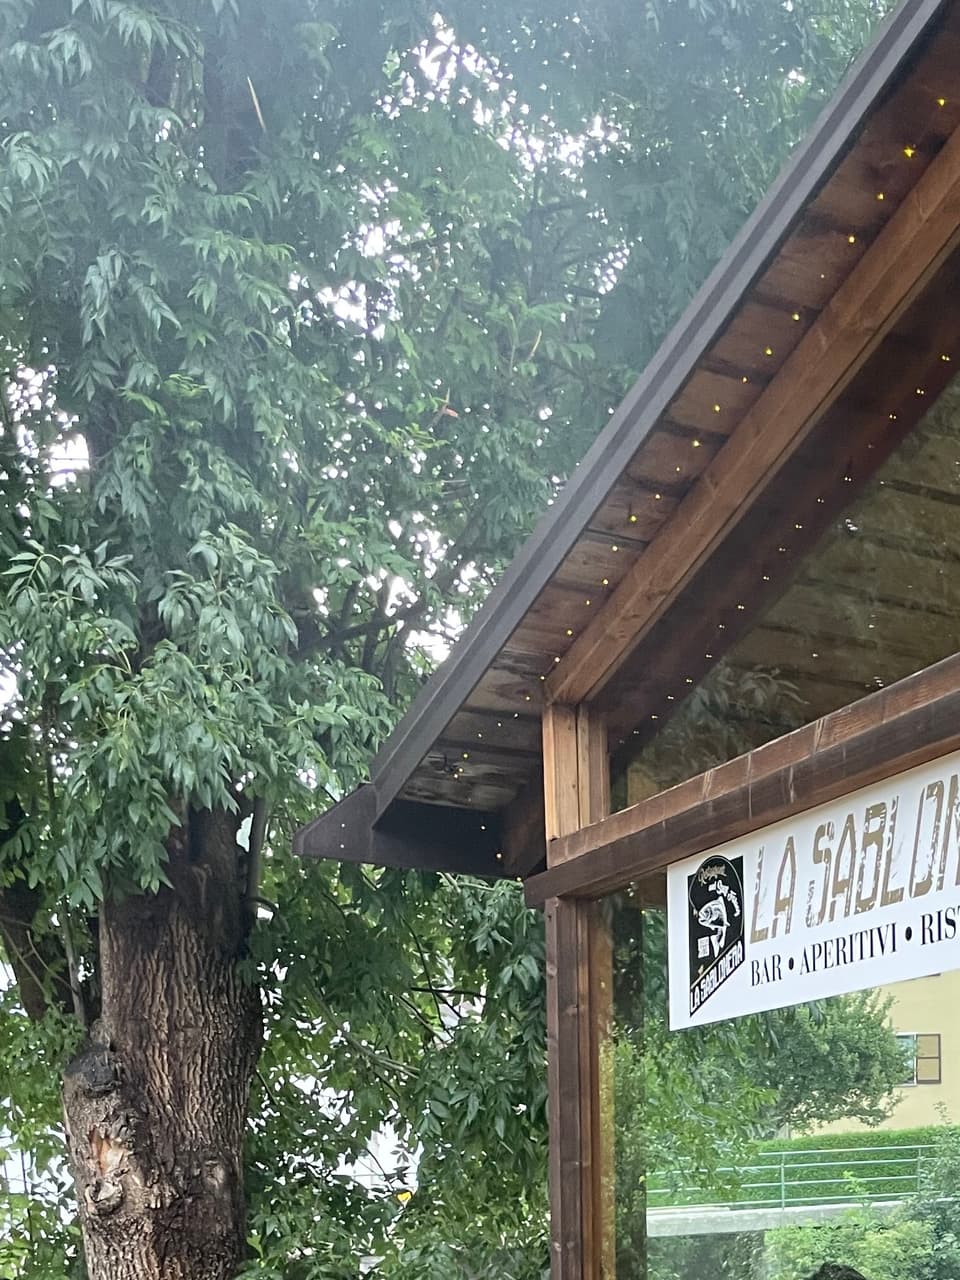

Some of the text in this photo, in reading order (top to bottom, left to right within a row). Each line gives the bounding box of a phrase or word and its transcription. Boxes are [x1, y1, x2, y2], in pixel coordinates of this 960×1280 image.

[750, 836, 797, 945] LA
[751, 953, 782, 987] BAR
[799, 922, 897, 975] APERITIVI
[690, 988, 701, 1014] LA
